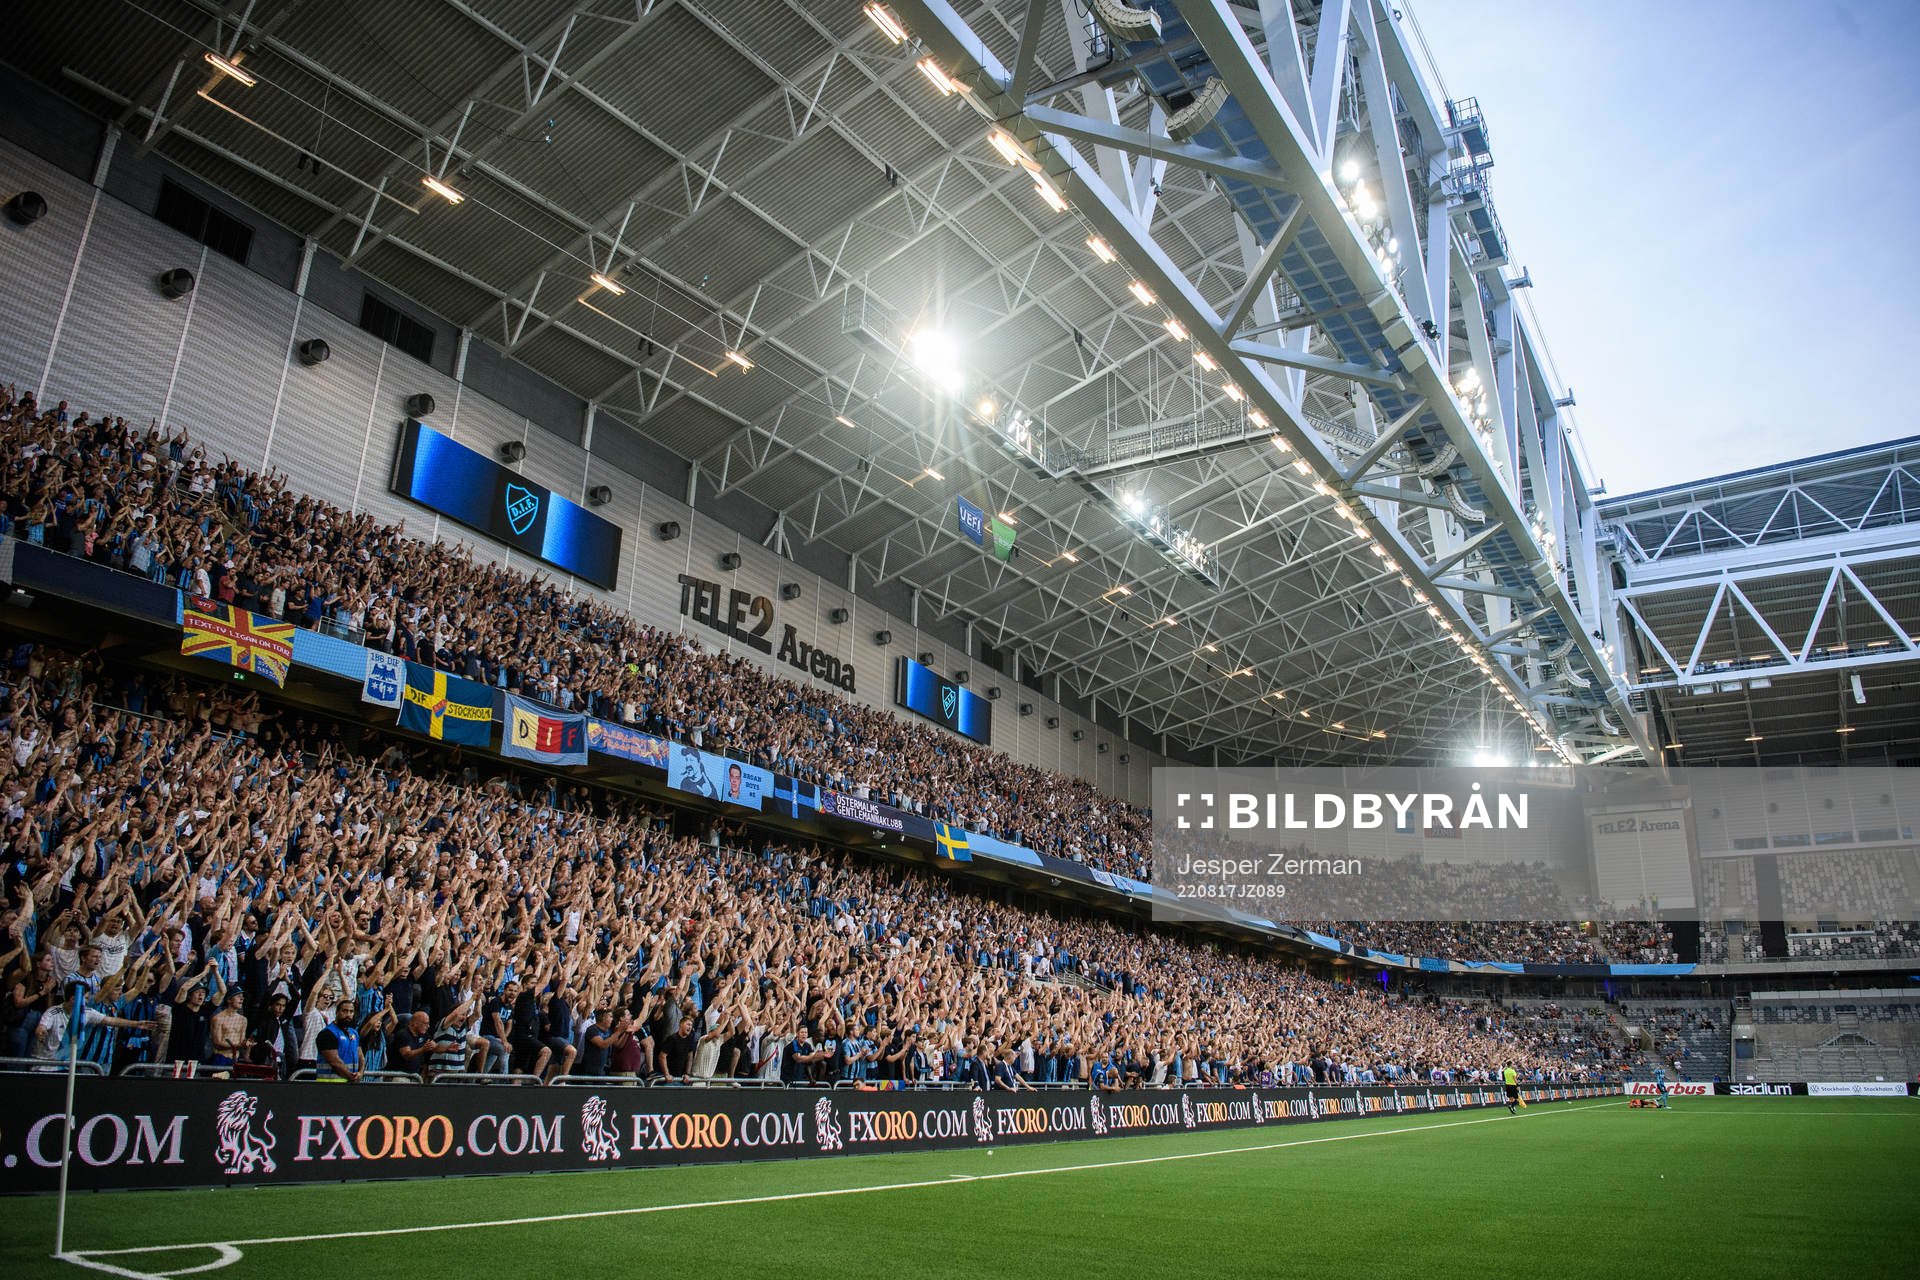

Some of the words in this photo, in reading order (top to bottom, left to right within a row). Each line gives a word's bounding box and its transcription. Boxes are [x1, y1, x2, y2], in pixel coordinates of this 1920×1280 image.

[188, 618, 227, 634] TEXT-TV
[229, 630, 258, 645] LIGAN
[259, 639, 271, 648] ON
[272, 643, 290, 656] TOUR
[678, 573, 774, 655] TELE2
[777, 623, 856, 694] Arena
[410, 689, 427, 704] DIF
[448, 704, 491, 719] STOCKHOLM
[836, 804, 904, 829] GENTLEMANNAKLUBB
[1597, 818, 1637, 834] TELE2
[1640, 821, 1680, 832] Arena
[1729, 1082, 1793, 1096] stadium
[1820, 1084, 1850, 1092] Stockholm
[1863, 1084, 1893, 1092] Stockholm
[996, 1106, 1087, 1135] FXORO.COM
[1109, 1103, 1180, 1128] FXORO.COM
[1196, 1101, 1251, 1123] FXORO.COM
[1264, 1099, 1308, 1119] FXORO.COM
[294, 1114, 565, 1161] FXORO.COM
[630, 1112, 805, 1151] FXORO.COM
[847, 1109, 968, 1142] FXORO.COM
